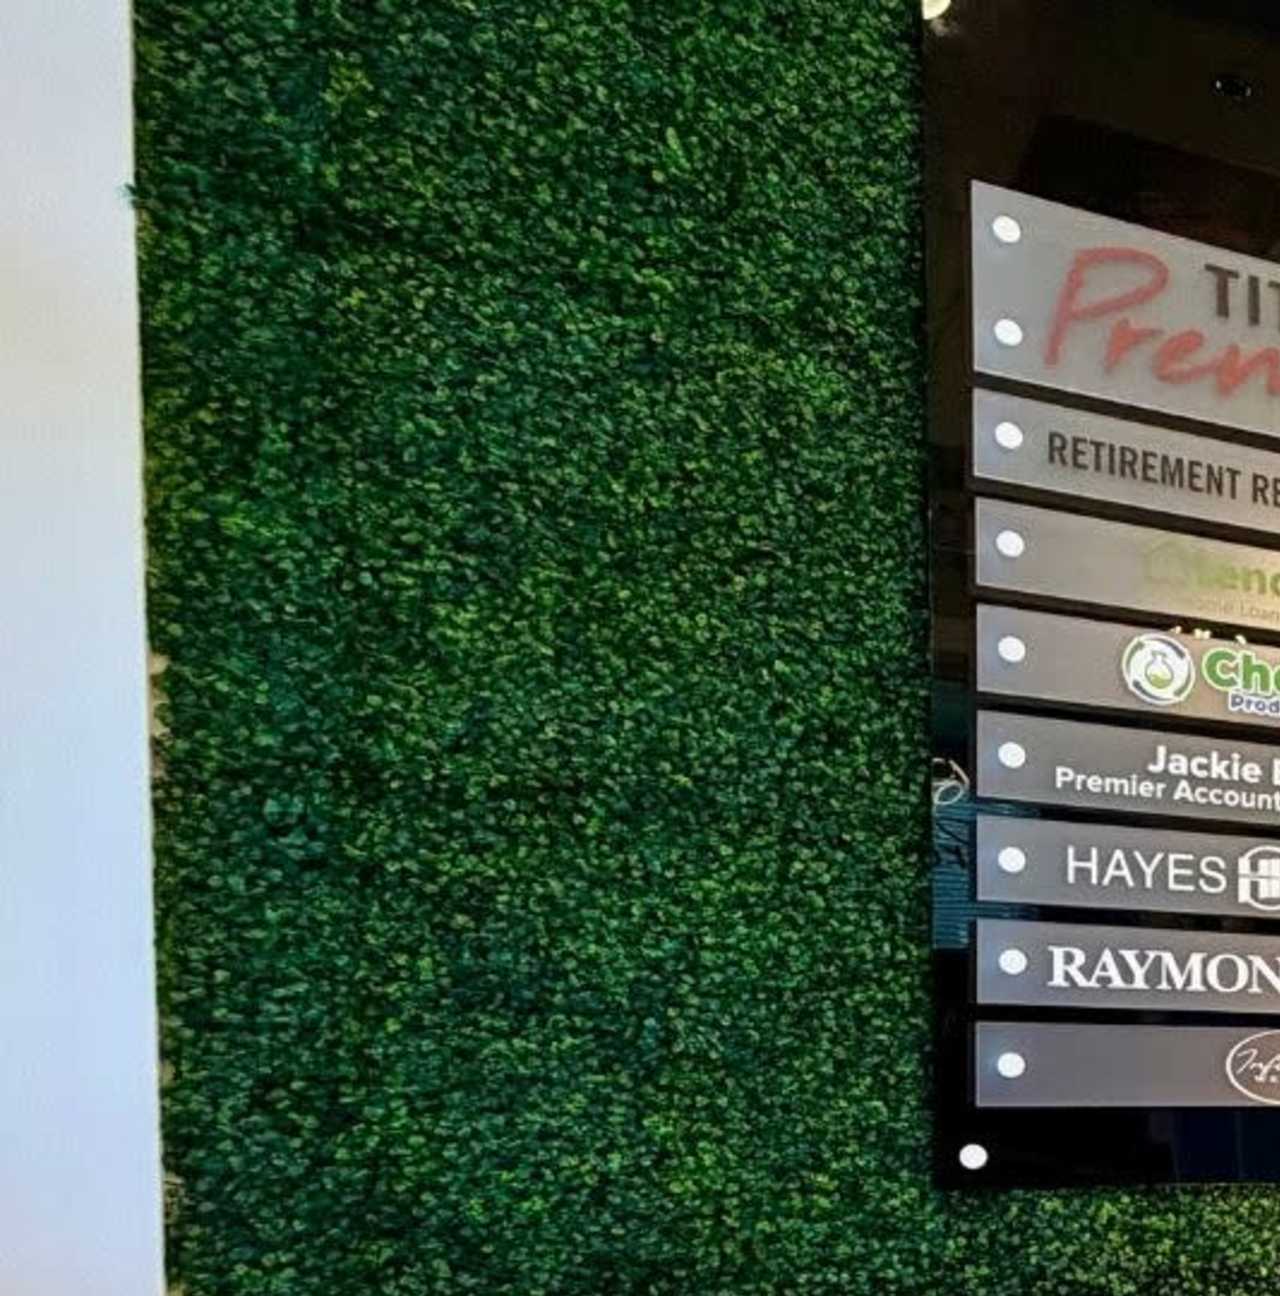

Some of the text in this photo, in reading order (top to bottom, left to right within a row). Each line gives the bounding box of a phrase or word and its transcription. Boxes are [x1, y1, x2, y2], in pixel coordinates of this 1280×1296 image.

[1048, 431, 1241, 500] RETIREMENT
[1055, 766, 1166, 799] Premier
[1148, 745, 1263, 784] Jackie
[1066, 846, 1227, 895] HAYES
